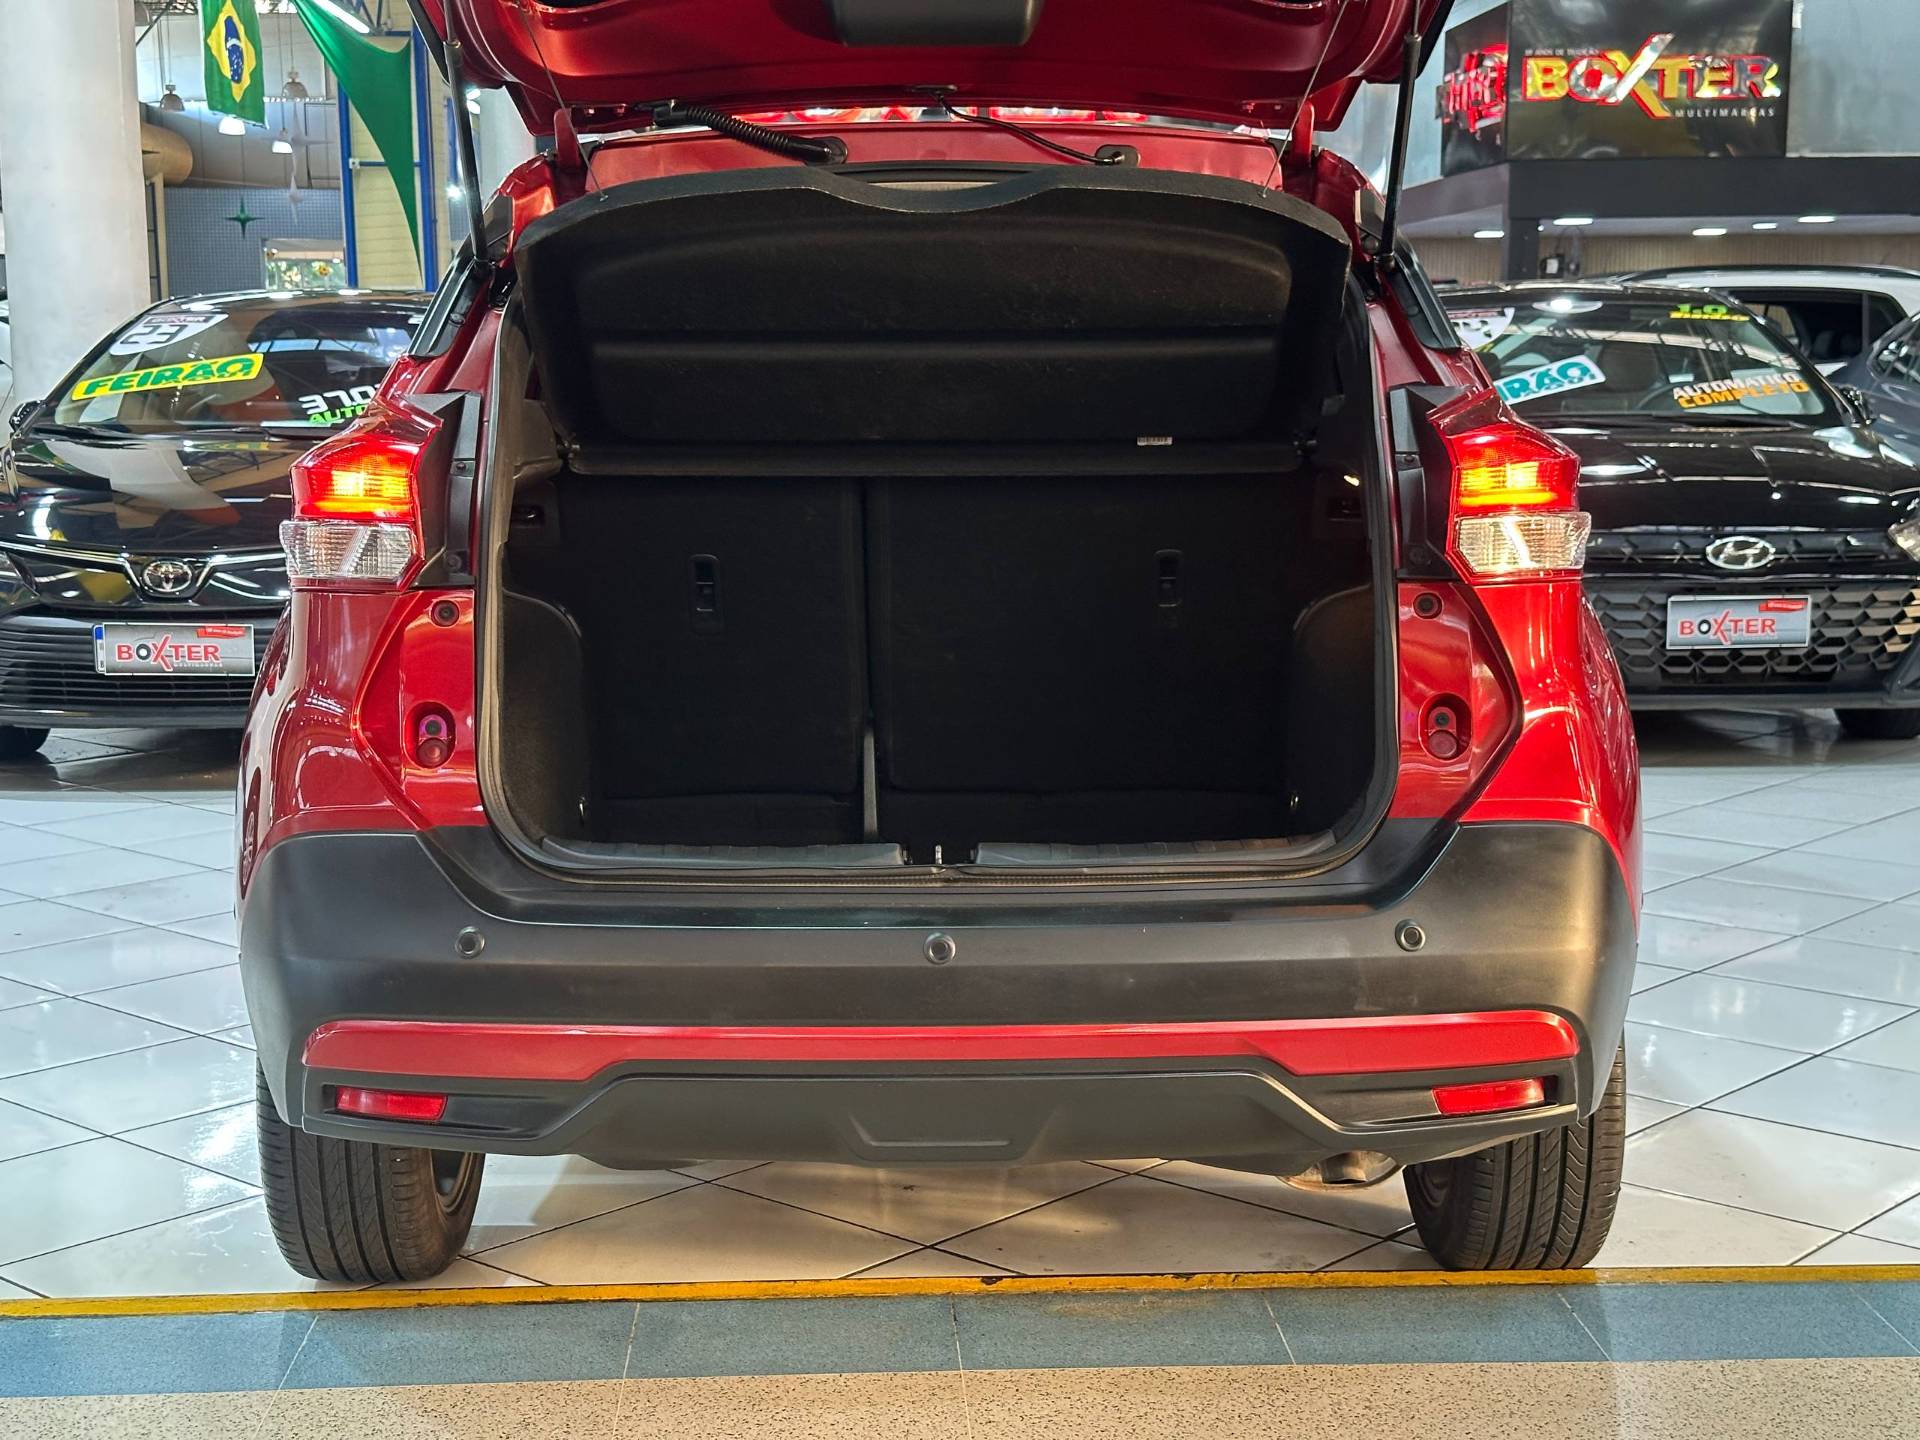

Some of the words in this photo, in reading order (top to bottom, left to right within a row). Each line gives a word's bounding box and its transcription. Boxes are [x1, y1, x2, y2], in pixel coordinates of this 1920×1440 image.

[1522, 32, 1781, 119] BOXTER
[1674, 106, 1775, 118] MULTIMARCAS
[1677, 303, 1728, 314] 1.0
[119, 324, 189, 345] 23
[83, 357, 255, 396] FEIRÃO
[1678, 380, 1809, 410] COMPLETO
[1679, 608, 1777, 645] BOXTER
[116, 634, 221, 671] BOXTER
